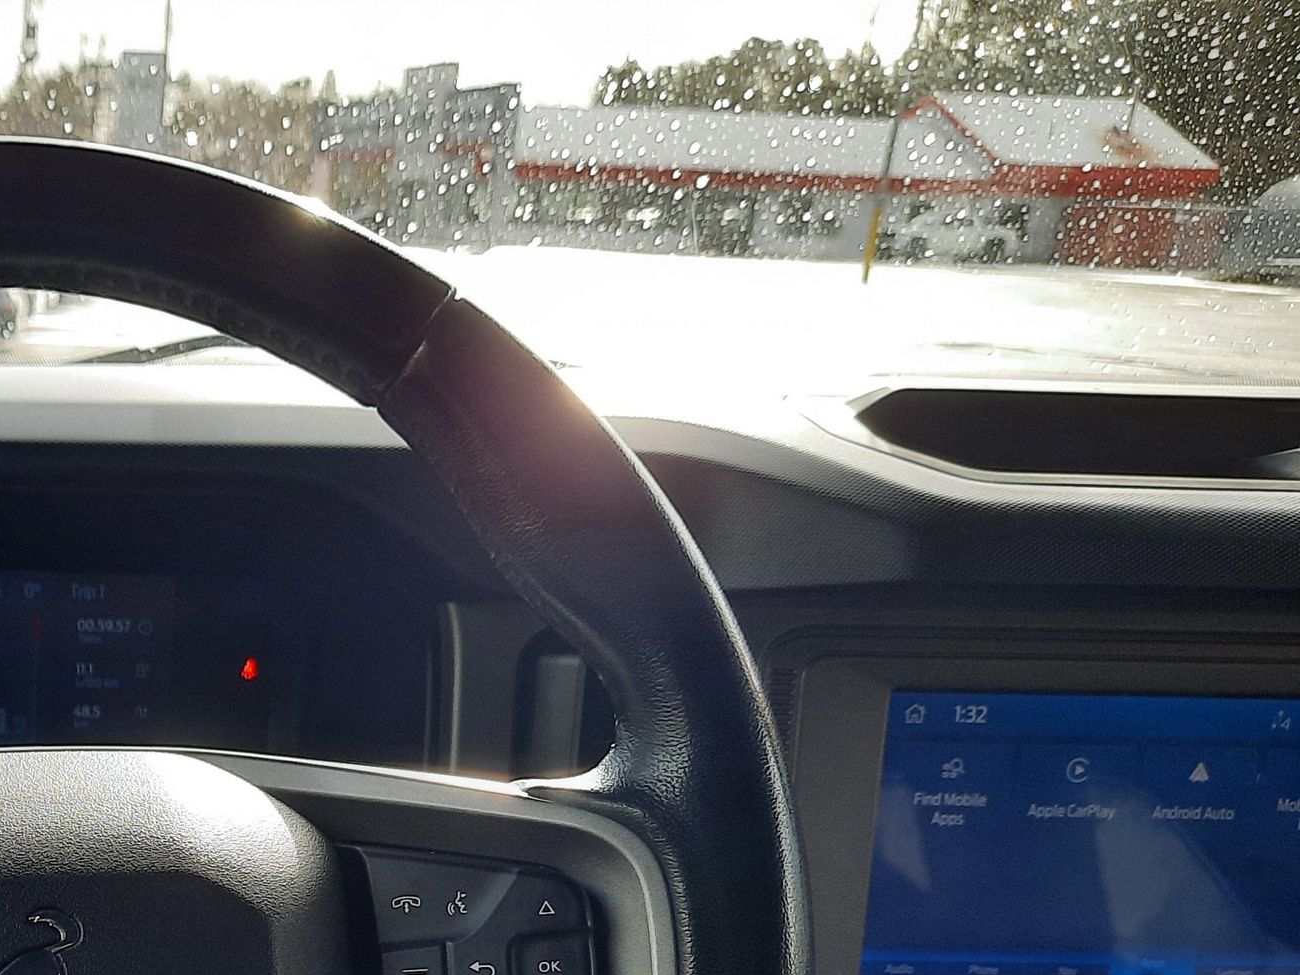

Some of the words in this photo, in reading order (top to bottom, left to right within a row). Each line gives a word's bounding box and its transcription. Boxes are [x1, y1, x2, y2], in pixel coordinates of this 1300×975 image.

[954, 704, 988, 725] 1:32
[913, 792, 941, 806] Find
[944, 793, 988, 807] Mobile
[931, 811, 964, 827] Apps
[1027, 803, 1065, 820] Apple
[1067, 804, 1116, 820] CarPlay
[1152, 806, 1202, 820] Android
[1203, 807, 1235, 821] Auto
[538, 960, 562, 974] OK
